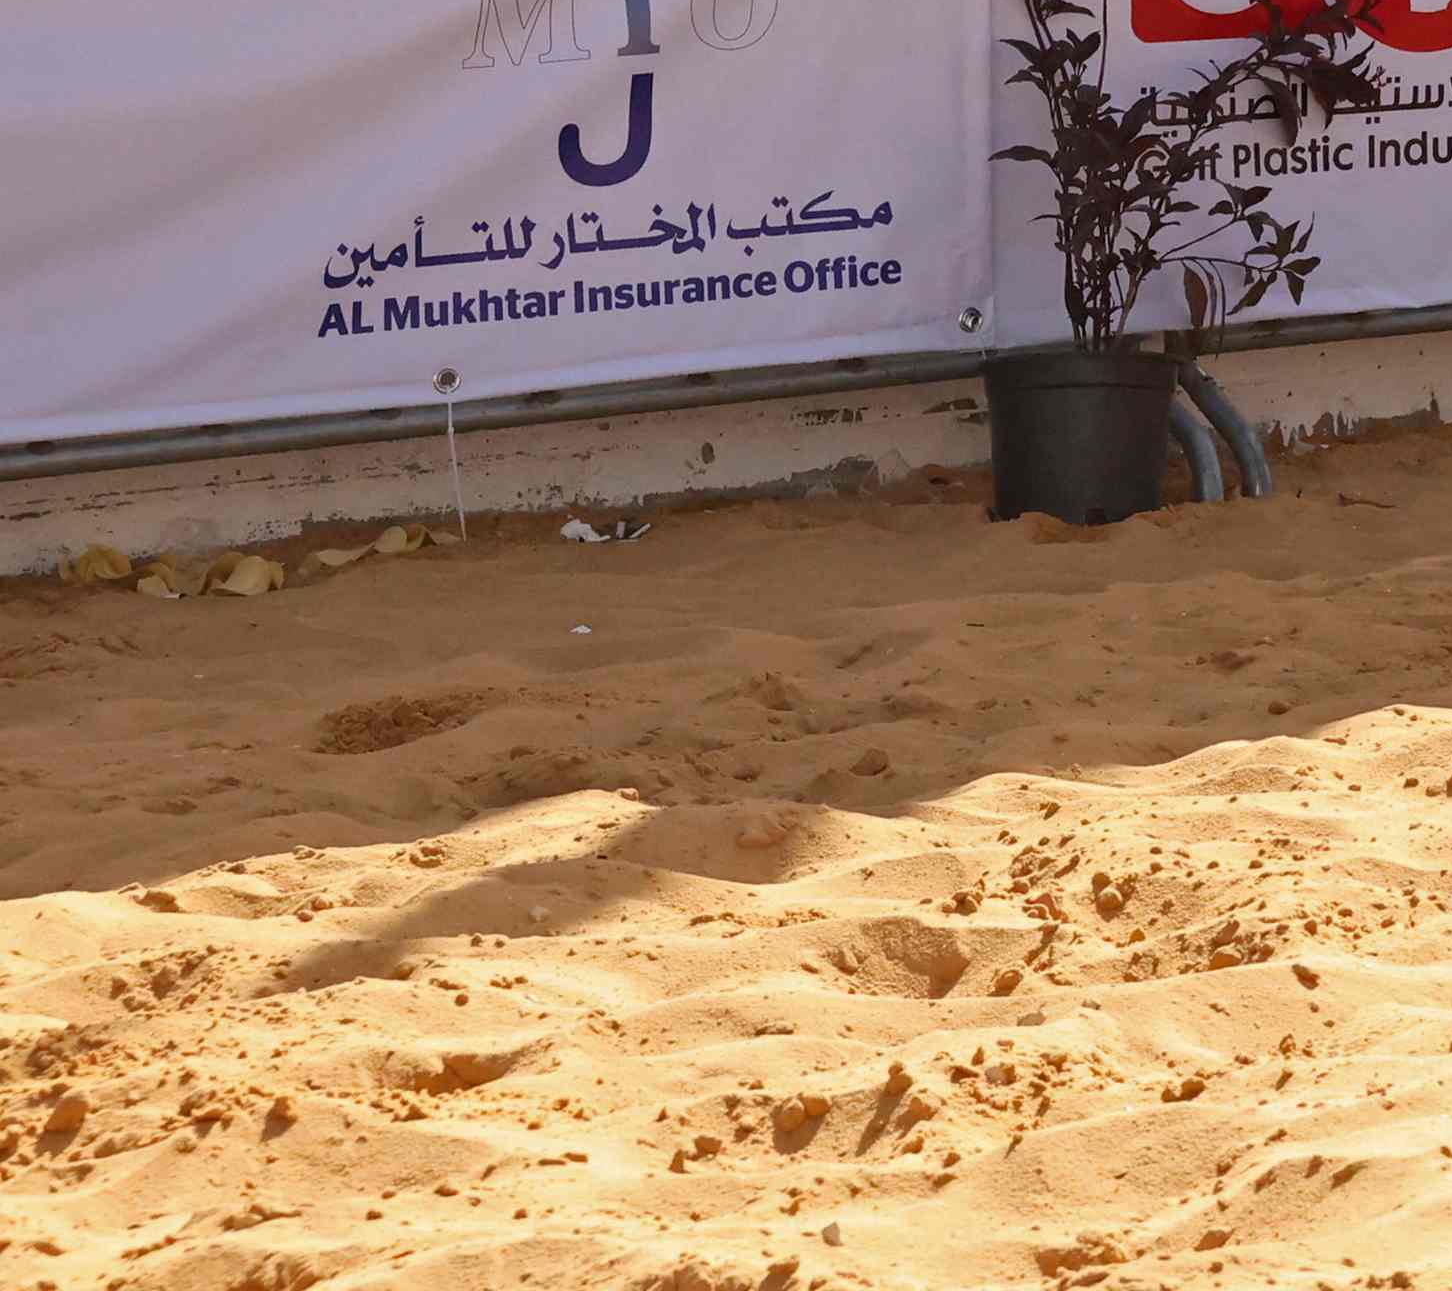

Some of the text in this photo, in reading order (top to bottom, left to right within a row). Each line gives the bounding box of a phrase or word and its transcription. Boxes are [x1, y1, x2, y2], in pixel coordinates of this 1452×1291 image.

[1233, 137, 1355, 178] Plastic
[323, 190, 894, 289] مكتب المختار للتأمين
[318, 256, 902, 337] AL Mukhtar Insurance Office
